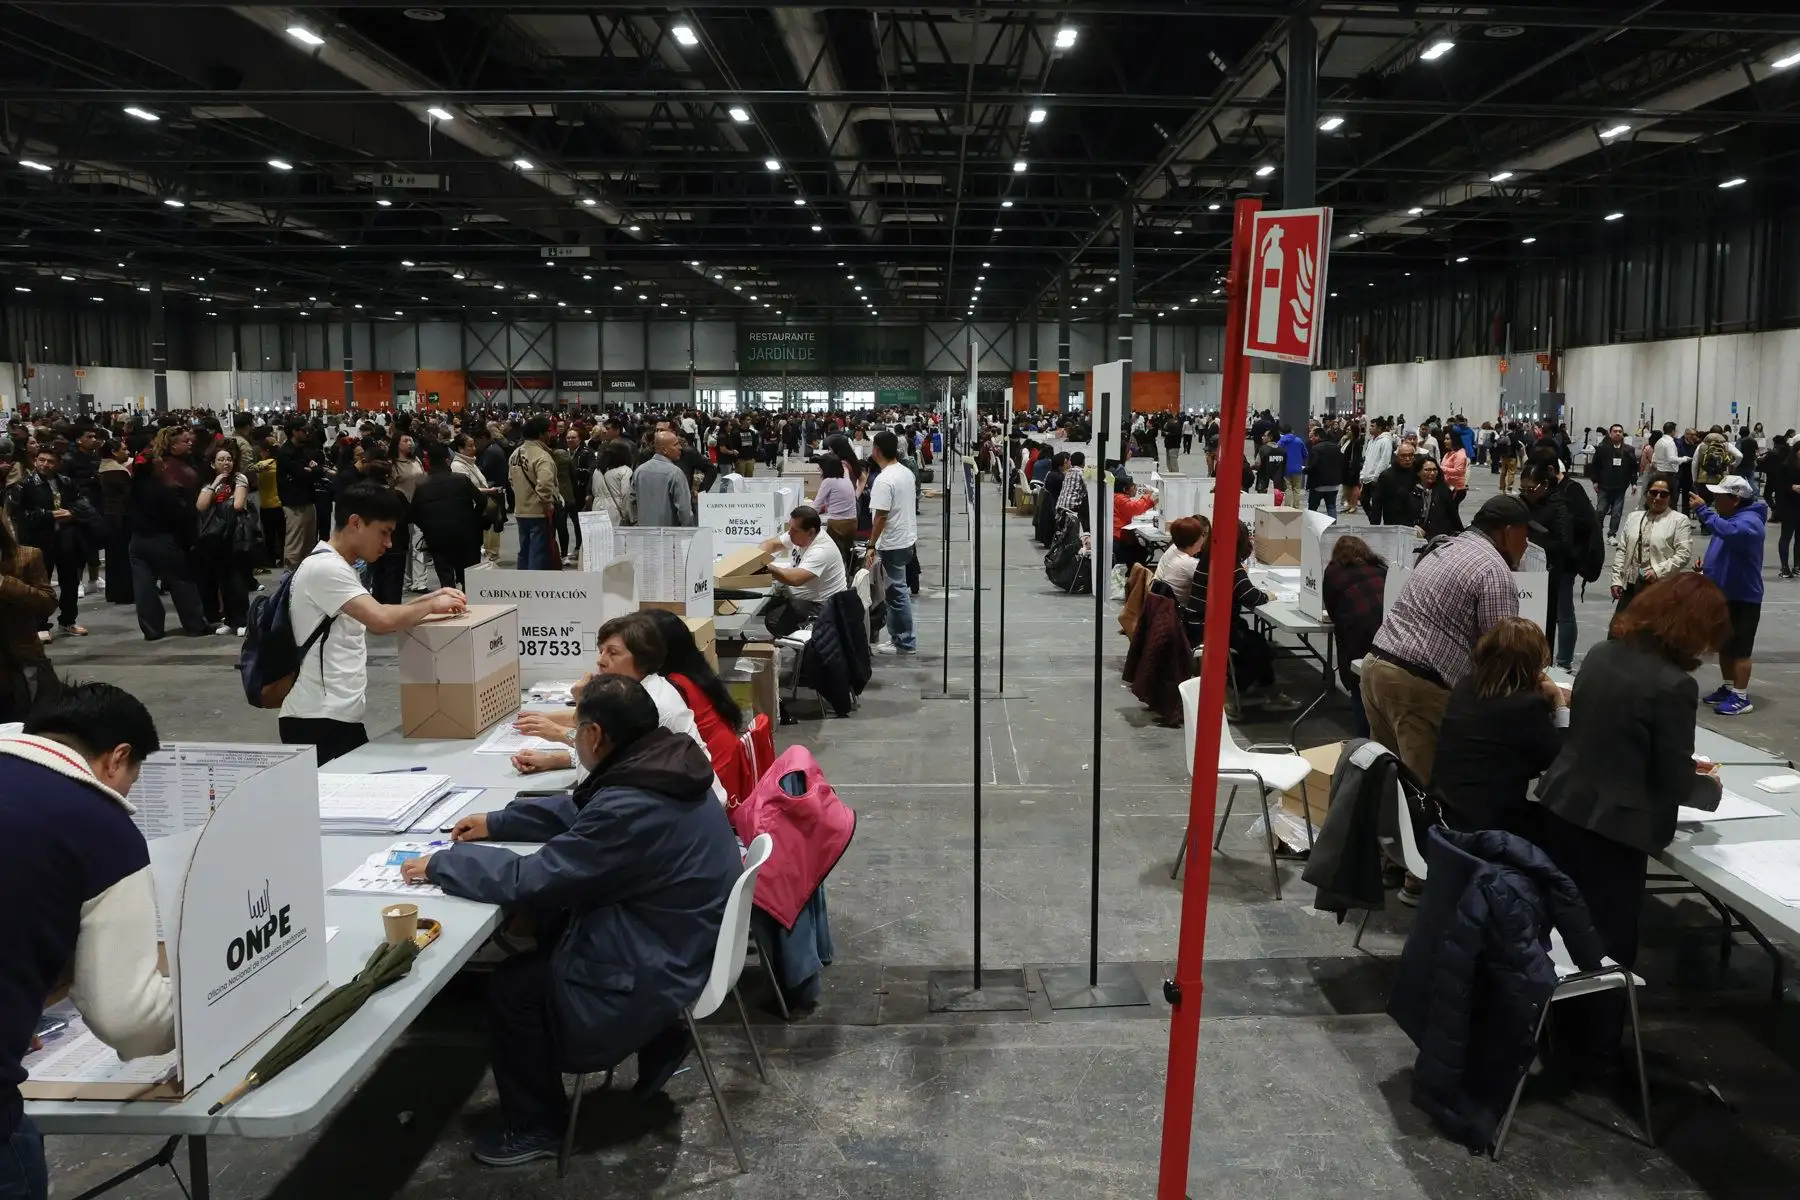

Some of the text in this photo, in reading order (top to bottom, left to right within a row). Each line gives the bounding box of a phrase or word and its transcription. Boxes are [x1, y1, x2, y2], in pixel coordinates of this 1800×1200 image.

[749, 332, 815, 341] RESTAURANTE
[611, 380, 636, 388] CAFETERÍA
[725, 526, 762, 536] 087534
[694, 579, 708, 594] ONPE
[480, 588, 588, 599] CABINA DE VOTACIÓN
[521, 626, 557, 637] MESA
[489, 635, 503, 650] ONPE
[226, 904, 291, 971] ONPE
[207, 927, 307, 1000] Oficina Nacional de Procesos Electorales
